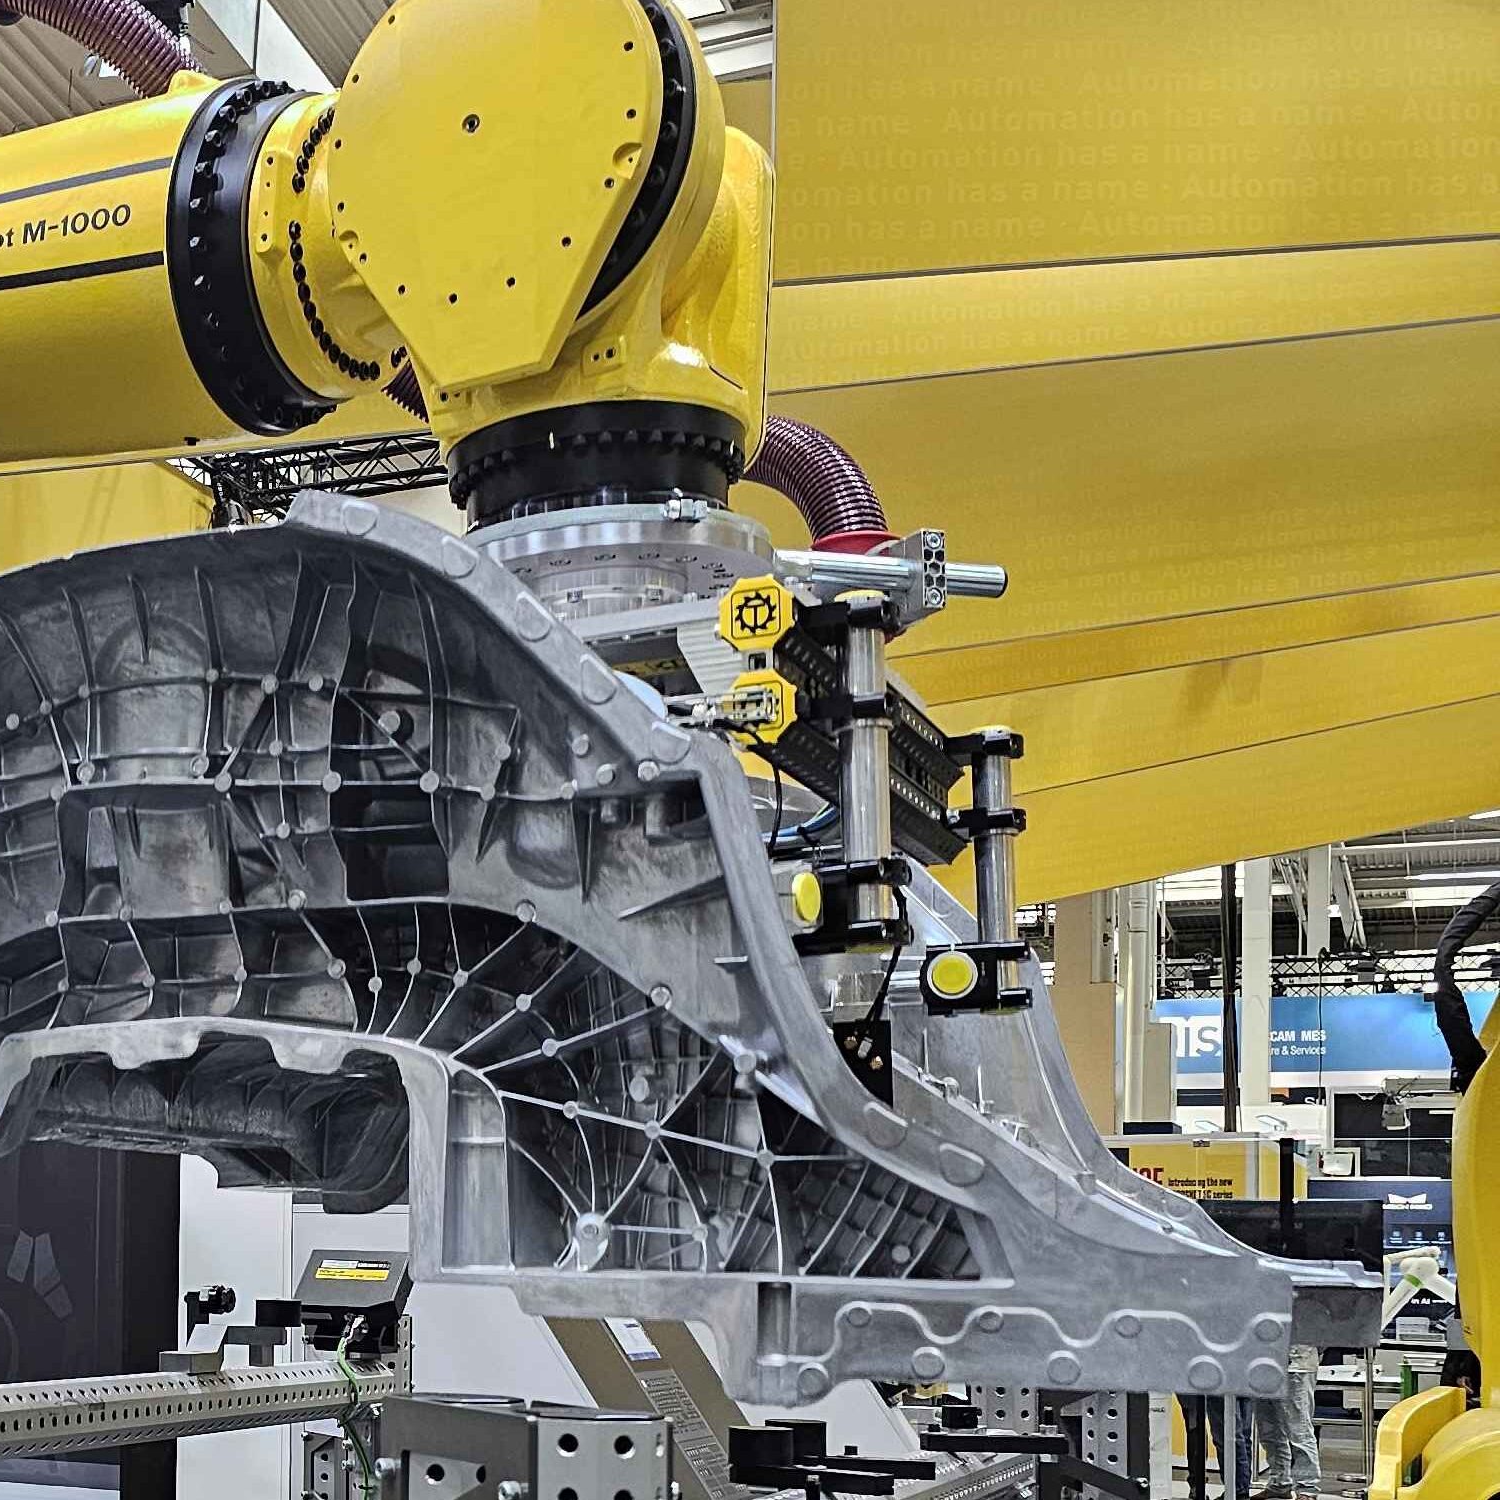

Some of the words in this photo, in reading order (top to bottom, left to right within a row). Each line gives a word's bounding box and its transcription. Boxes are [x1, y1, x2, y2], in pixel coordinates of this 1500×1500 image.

[941, 104, 1149, 134] Automation
[837, 141, 1044, 172] Automation
[946, 176, 1008, 205] has
[1053, 179, 1149, 203] name
[1180, 168, 1394, 201] Automation
[1405, 166, 1468, 197] has
[22, 203, 131, 244] M-1000
[845, 215, 906, 242] has
[951, 215, 1047, 239] name
[1270, 1030, 1296, 1042] CAM
[1301, 1030, 1327, 1042] MES
[1281, 1045, 1289, 1056] &
[1290, 1045, 1327, 1056] Services
